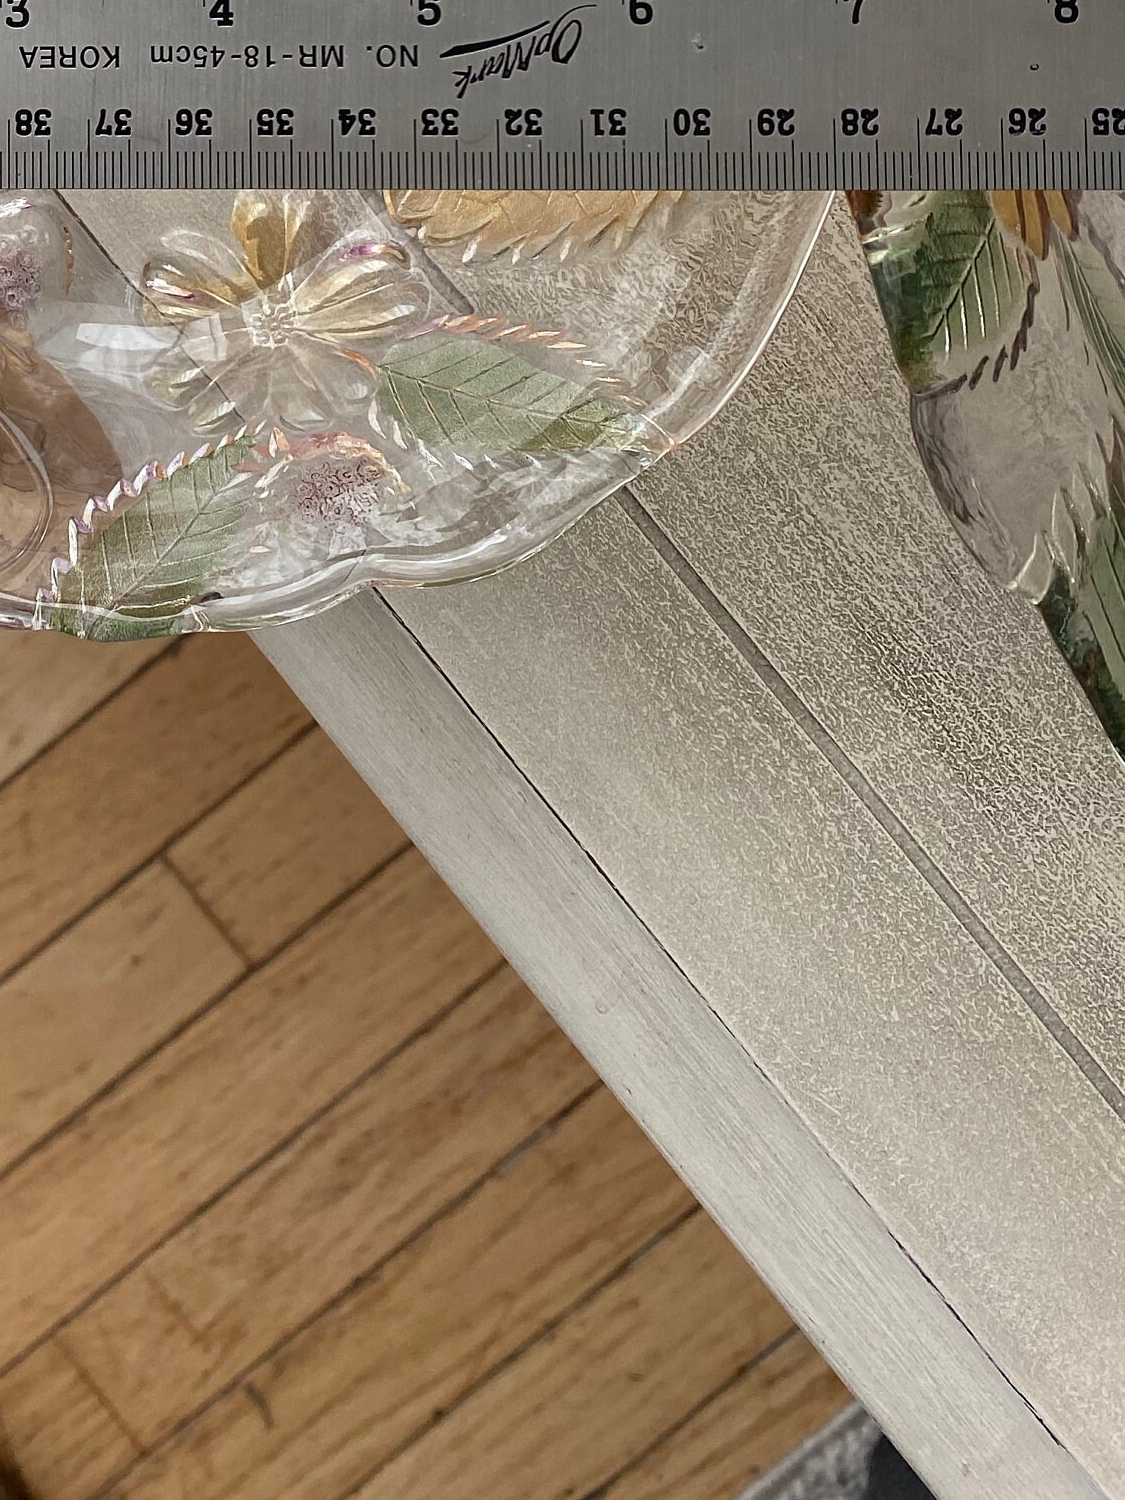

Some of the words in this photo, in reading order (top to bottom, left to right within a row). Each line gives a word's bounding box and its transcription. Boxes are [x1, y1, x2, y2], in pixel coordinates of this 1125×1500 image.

[18, 45, 120, 69] KOREA
[366, 44, 419, 68] NO.
[14, 108, 52, 137] 38
[94, 108, 132, 136] 37
[175, 108, 213, 136] 36
[256, 108, 294, 136] 35
[338, 108, 377, 136] 34
[421, 108, 460, 136] 33
[504, 108, 543, 136] 32
[589, 108, 627, 137] 31
[673, 108, 711, 137] 30
[757, 108, 795, 137] 29
[840, 108, 879, 137] 28
[924, 107, 963, 136] 27
[1008, 107, 1047, 136] 26
